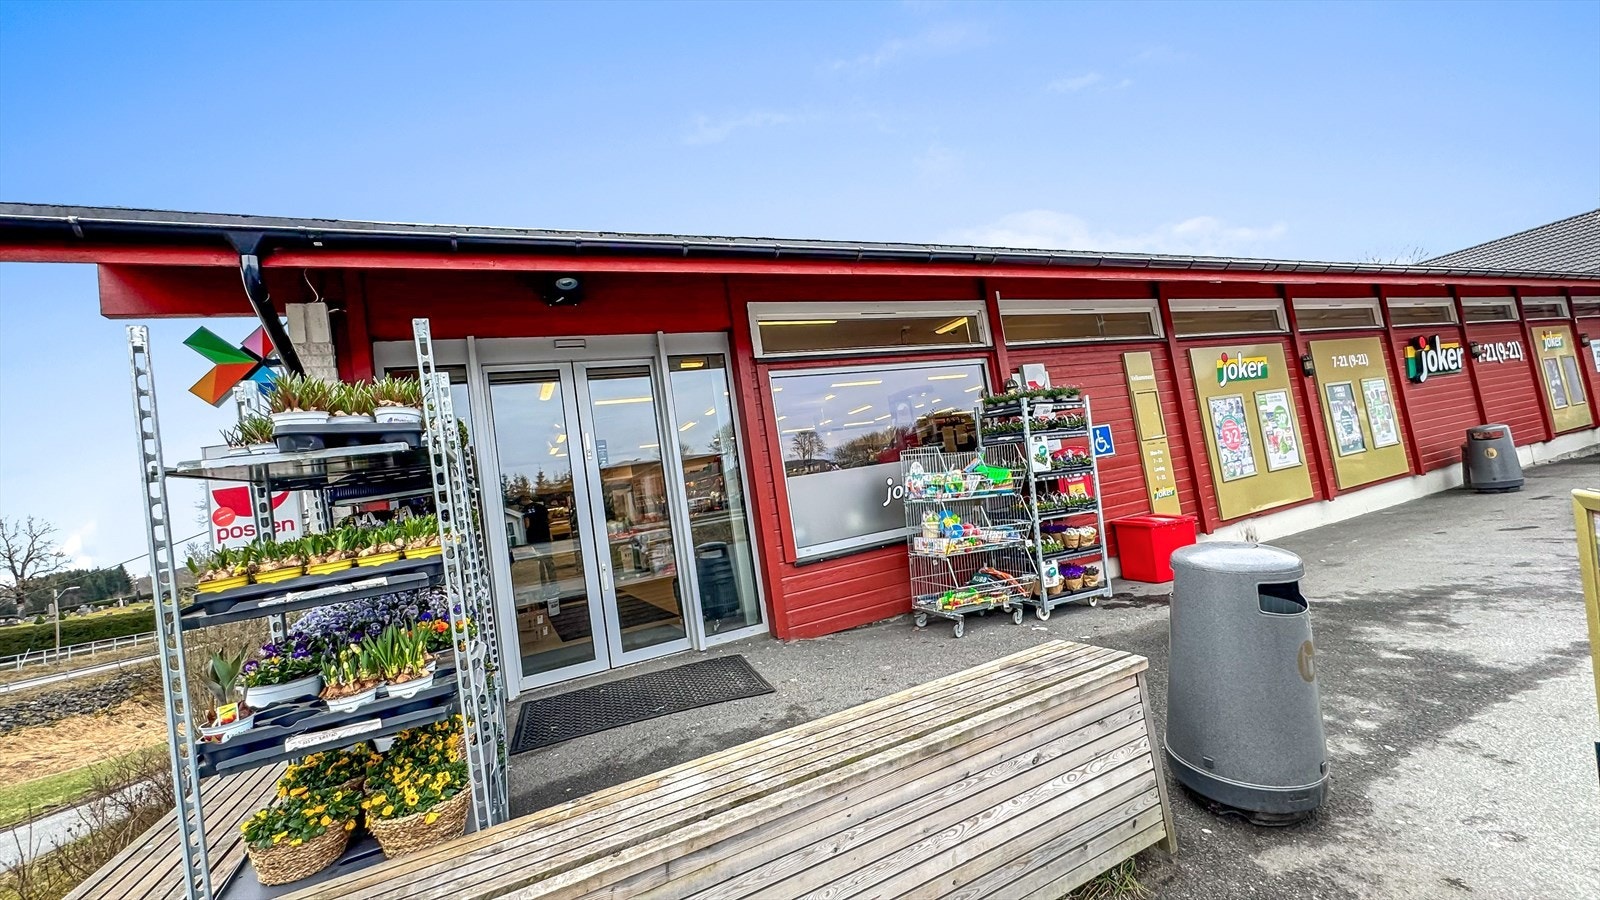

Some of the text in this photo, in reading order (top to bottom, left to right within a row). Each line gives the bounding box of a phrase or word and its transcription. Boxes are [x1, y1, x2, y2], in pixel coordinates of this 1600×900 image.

[1541, 330, 1563, 352] joker
[1219, 351, 1264, 388] joker
[1419, 335, 1464, 383] joker
[1154, 486, 1175, 500] joker
[216, 519, 295, 544] posen
